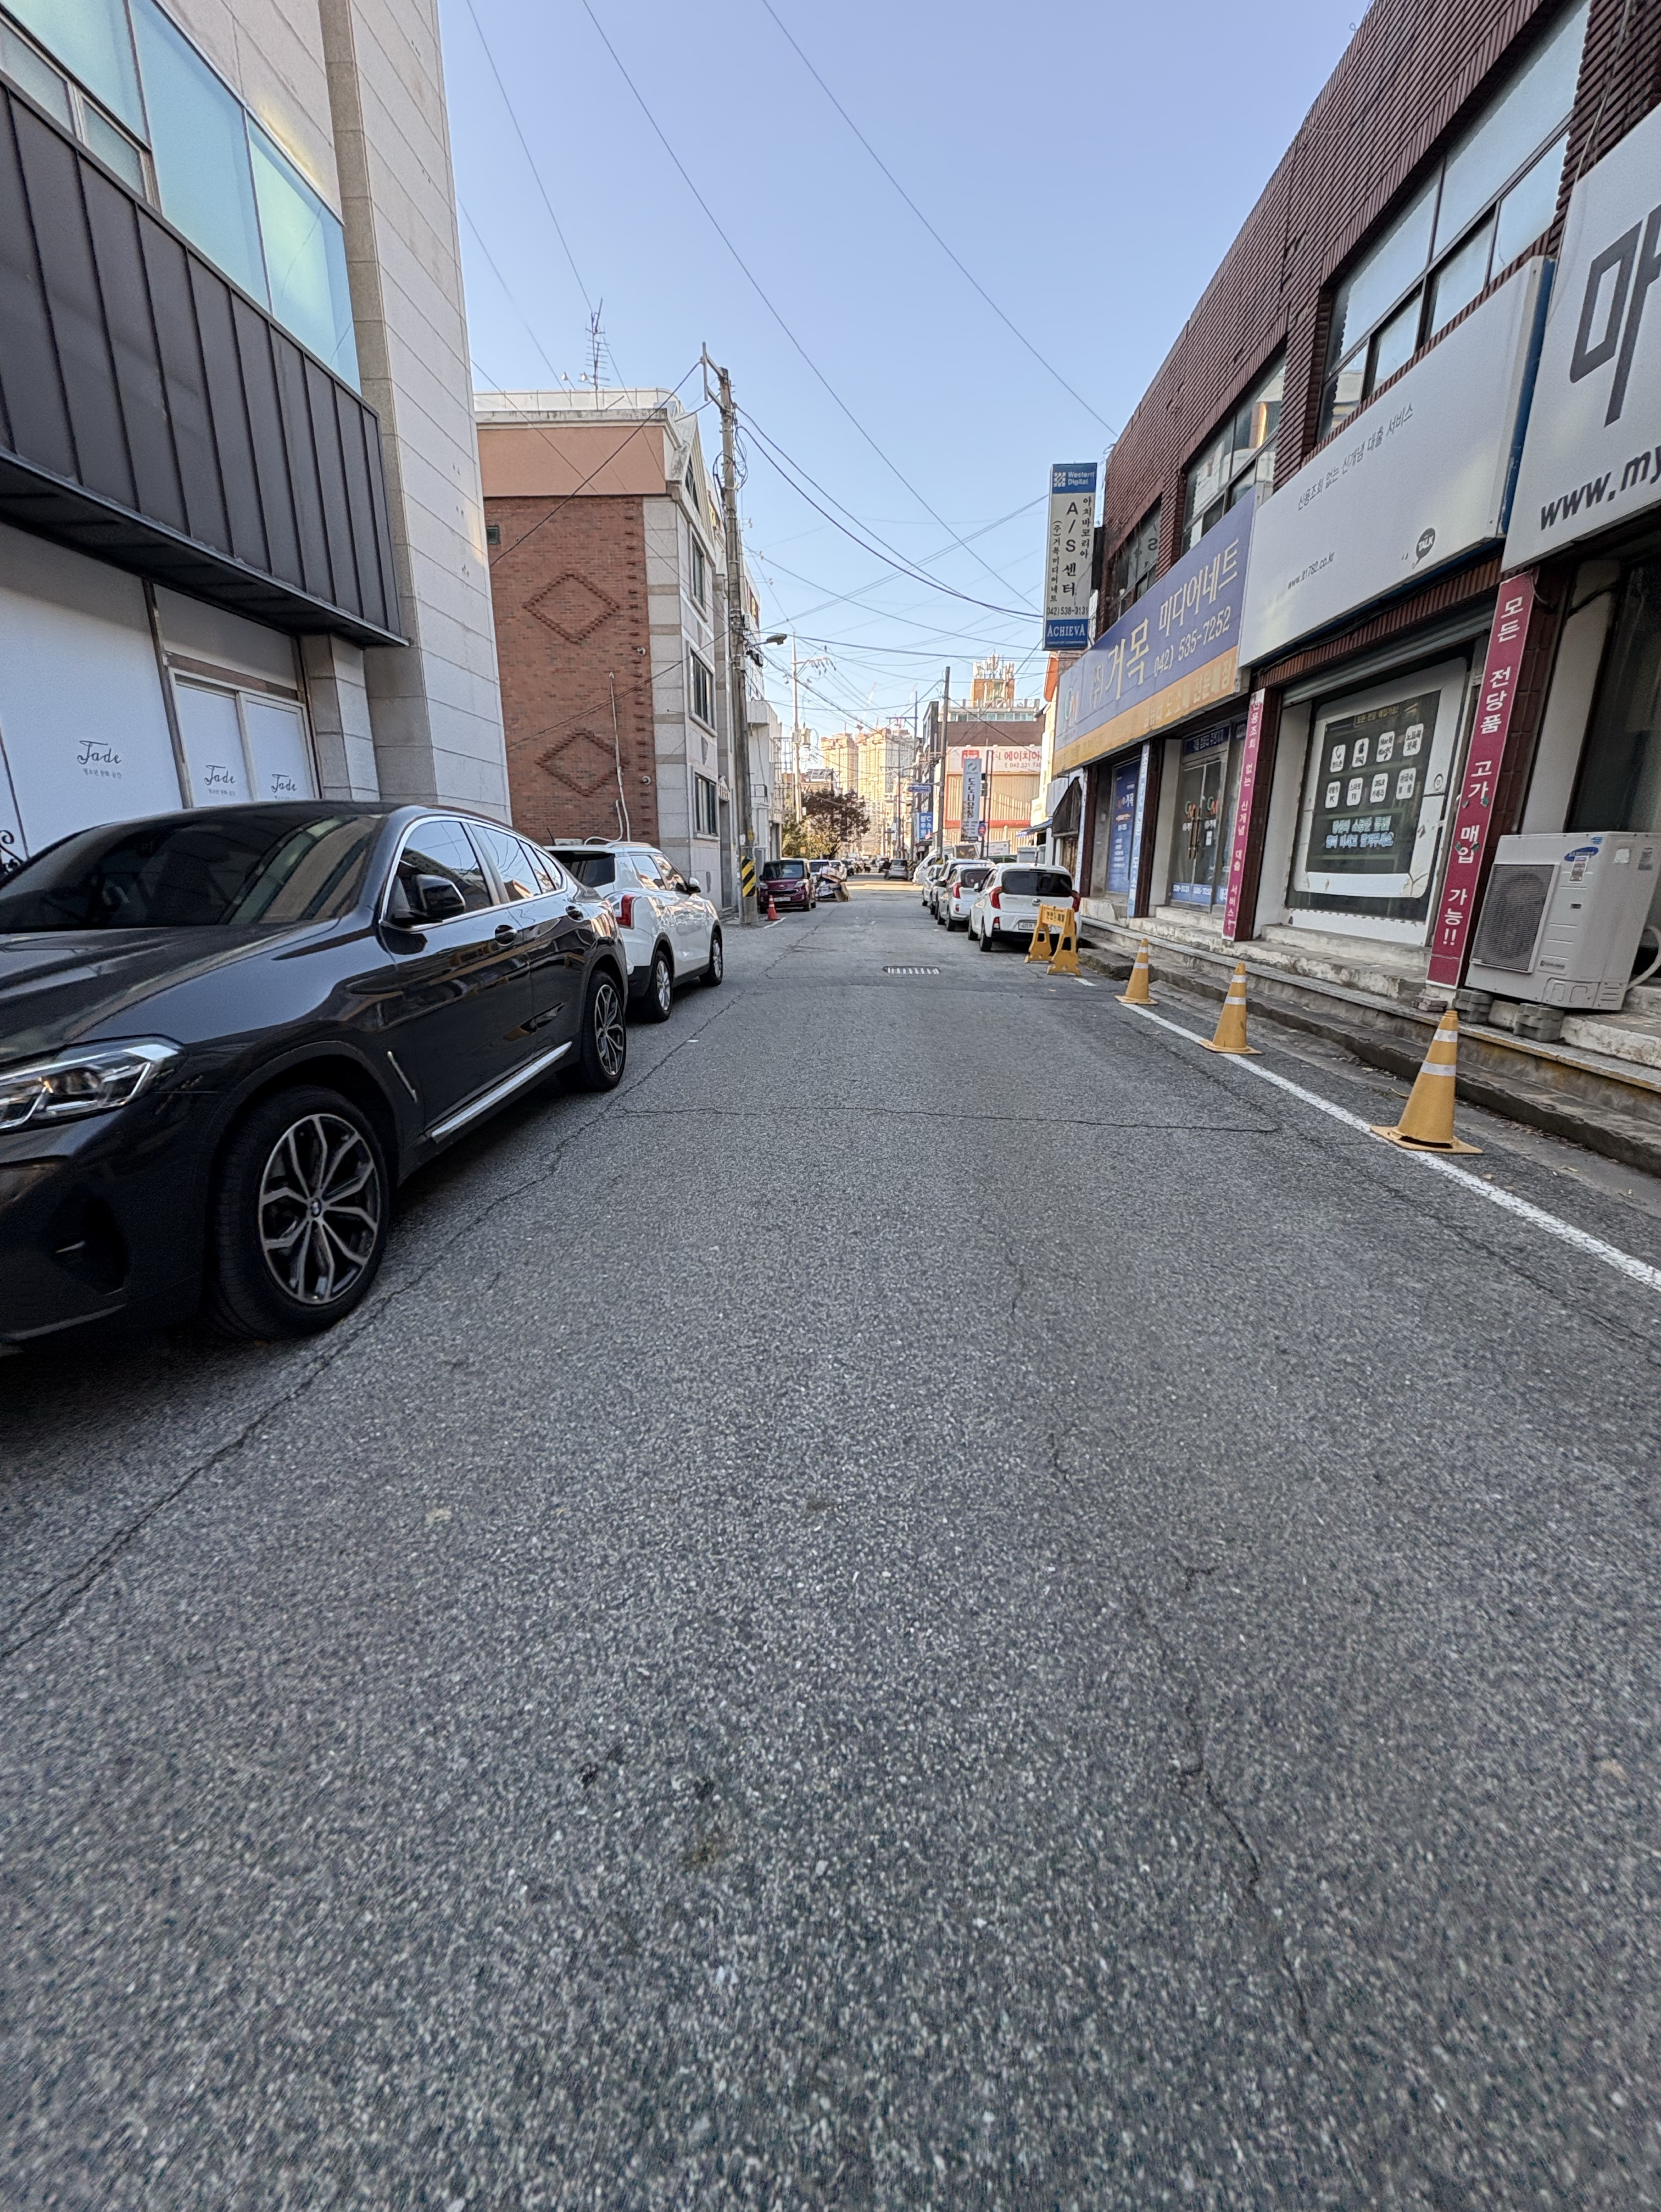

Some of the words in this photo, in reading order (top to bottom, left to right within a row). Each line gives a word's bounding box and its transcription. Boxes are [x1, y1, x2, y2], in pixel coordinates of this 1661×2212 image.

[1298, 477, 1324, 511] 신용조회
[1325, 467, 1340, 489] 없는
[1341, 441, 1365, 475] 신개념
[1367, 426, 1383, 451] 대출
[1386, 402, 1413, 436] 서비스
[1066, 502, 1078, 552] A/S
[1081, 496, 1092, 559] 아치바코리아
[1062, 562, 1076, 596] 센터
[1158, 537, 1240, 638] 미디어네트
[1047, 623, 1085, 637] ACHIEVA
[1154, 644, 1174, 677] 042)
[1178, 605, 1232, 662] 535-7252
[1496, 596, 1523, 644] 모든
[1480, 665, 1512, 735] 전당품
[77, 740, 121, 765] Jade
[204, 765, 236, 785] Jade
[271, 774, 297, 793] Jade
[1466, 760, 1493, 800] 고가
[1457, 824, 1481, 865] 매입
[1442, 888, 1468, 948] 가능!!
